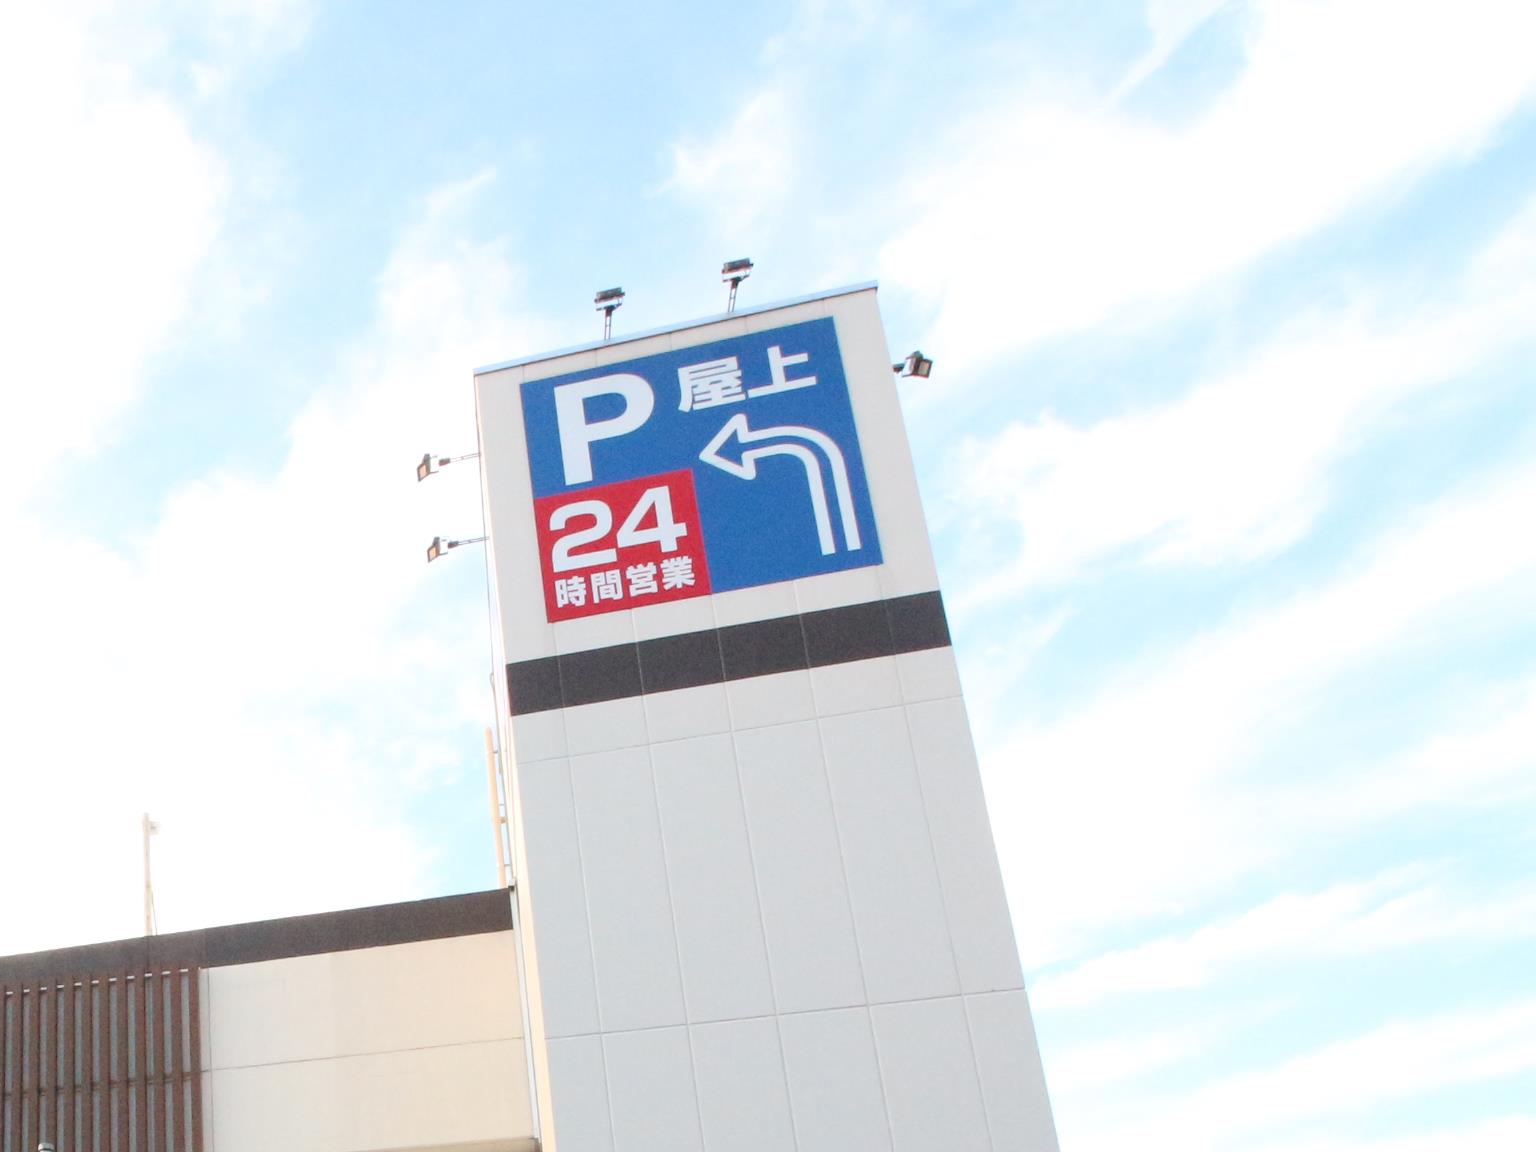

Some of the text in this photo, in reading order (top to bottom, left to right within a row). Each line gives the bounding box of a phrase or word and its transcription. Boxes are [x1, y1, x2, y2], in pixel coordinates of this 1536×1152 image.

[677, 346, 817, 412] 屋上
[554, 373, 655, 486] P
[549, 485, 688, 573] 24
[554, 556, 696, 608] 時間営業
